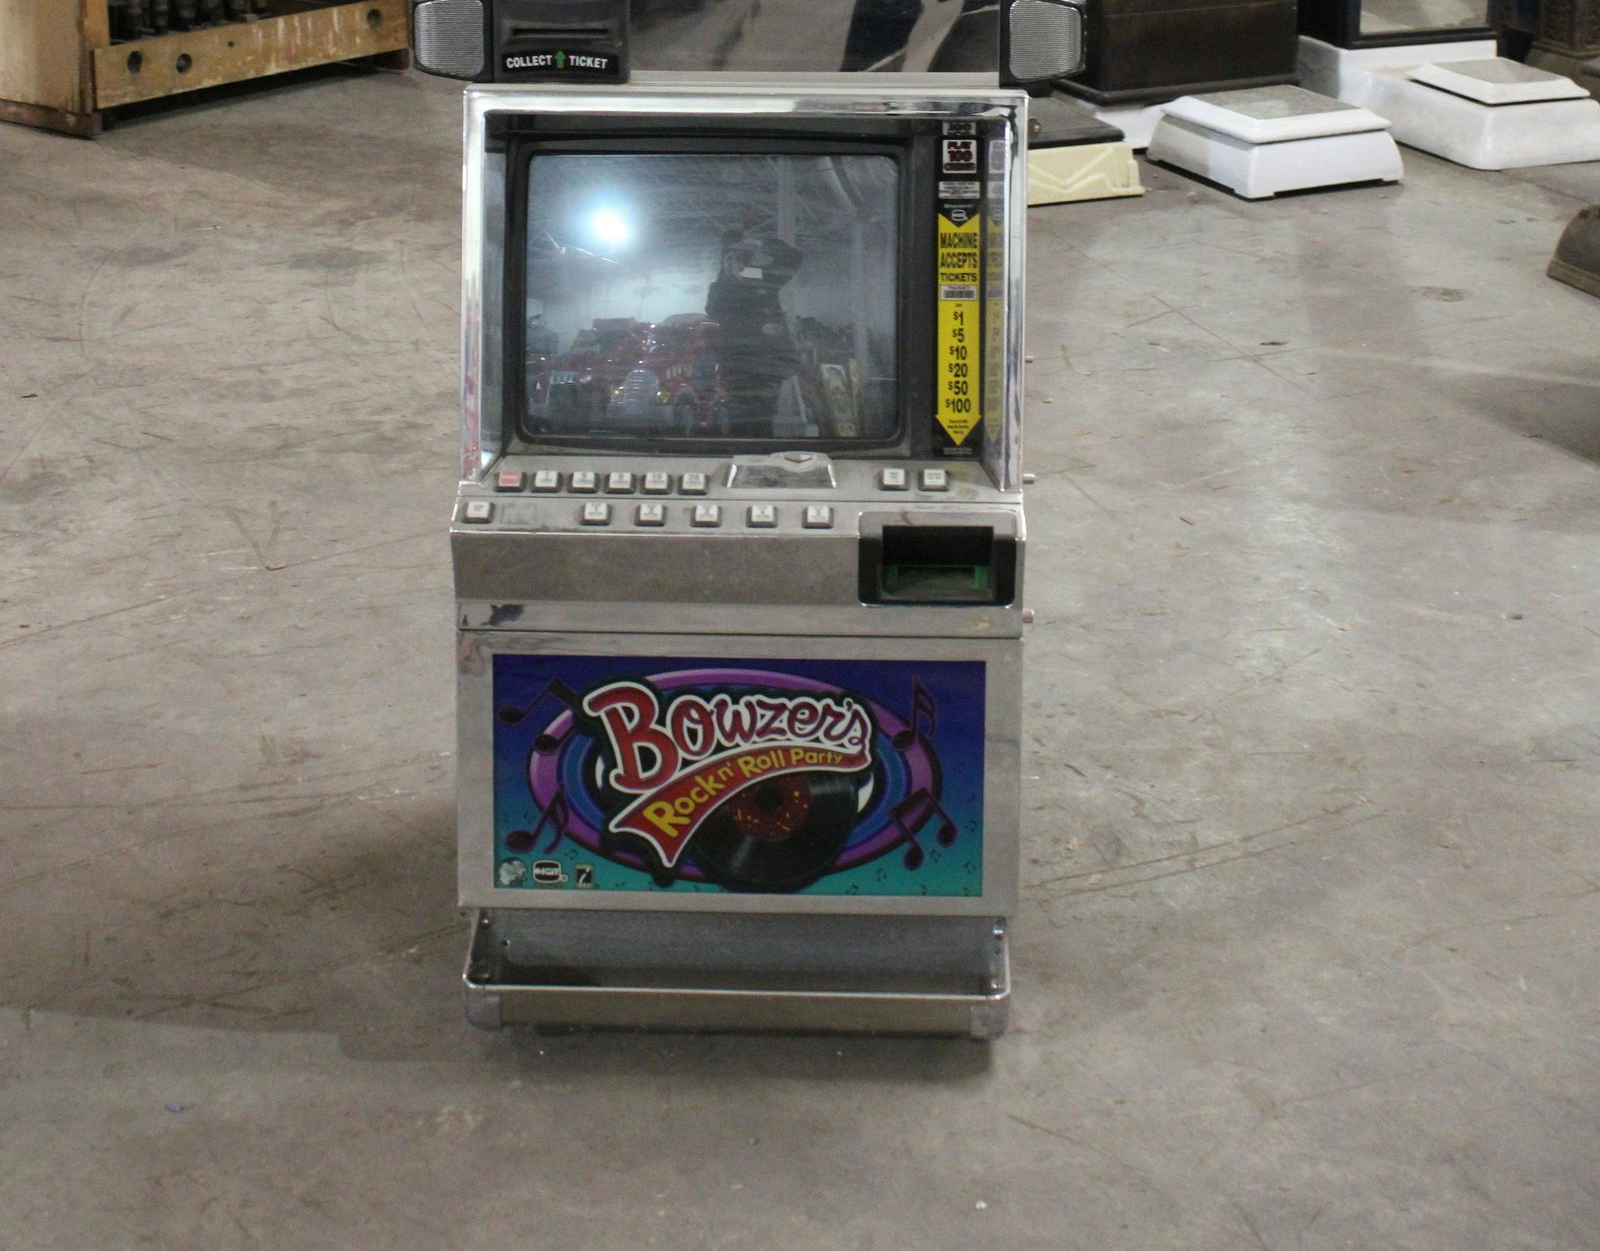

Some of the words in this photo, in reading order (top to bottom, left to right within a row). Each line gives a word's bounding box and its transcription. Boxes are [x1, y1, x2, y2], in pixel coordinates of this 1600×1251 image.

[505, 54, 553, 69] COLLECT
[568, 54, 608, 69] TICKET
[940, 231, 978, 249] MACHINE
[940, 252, 978, 270] ACCEPTS
[940, 272, 978, 282] TICKETS
[953, 311, 964, 326] $1
[952, 328, 965, 343] $5
[949, 345, 968, 361] $10
[948, 363, 968, 378] $20
[948, 380, 969, 396] $50
[945, 398, 971, 414] $100
[583, 681, 872, 794] Bowzer's
[642, 770, 726, 838] Rock
[737, 750, 787, 779] Roll
[791, 748, 843, 767] Party
